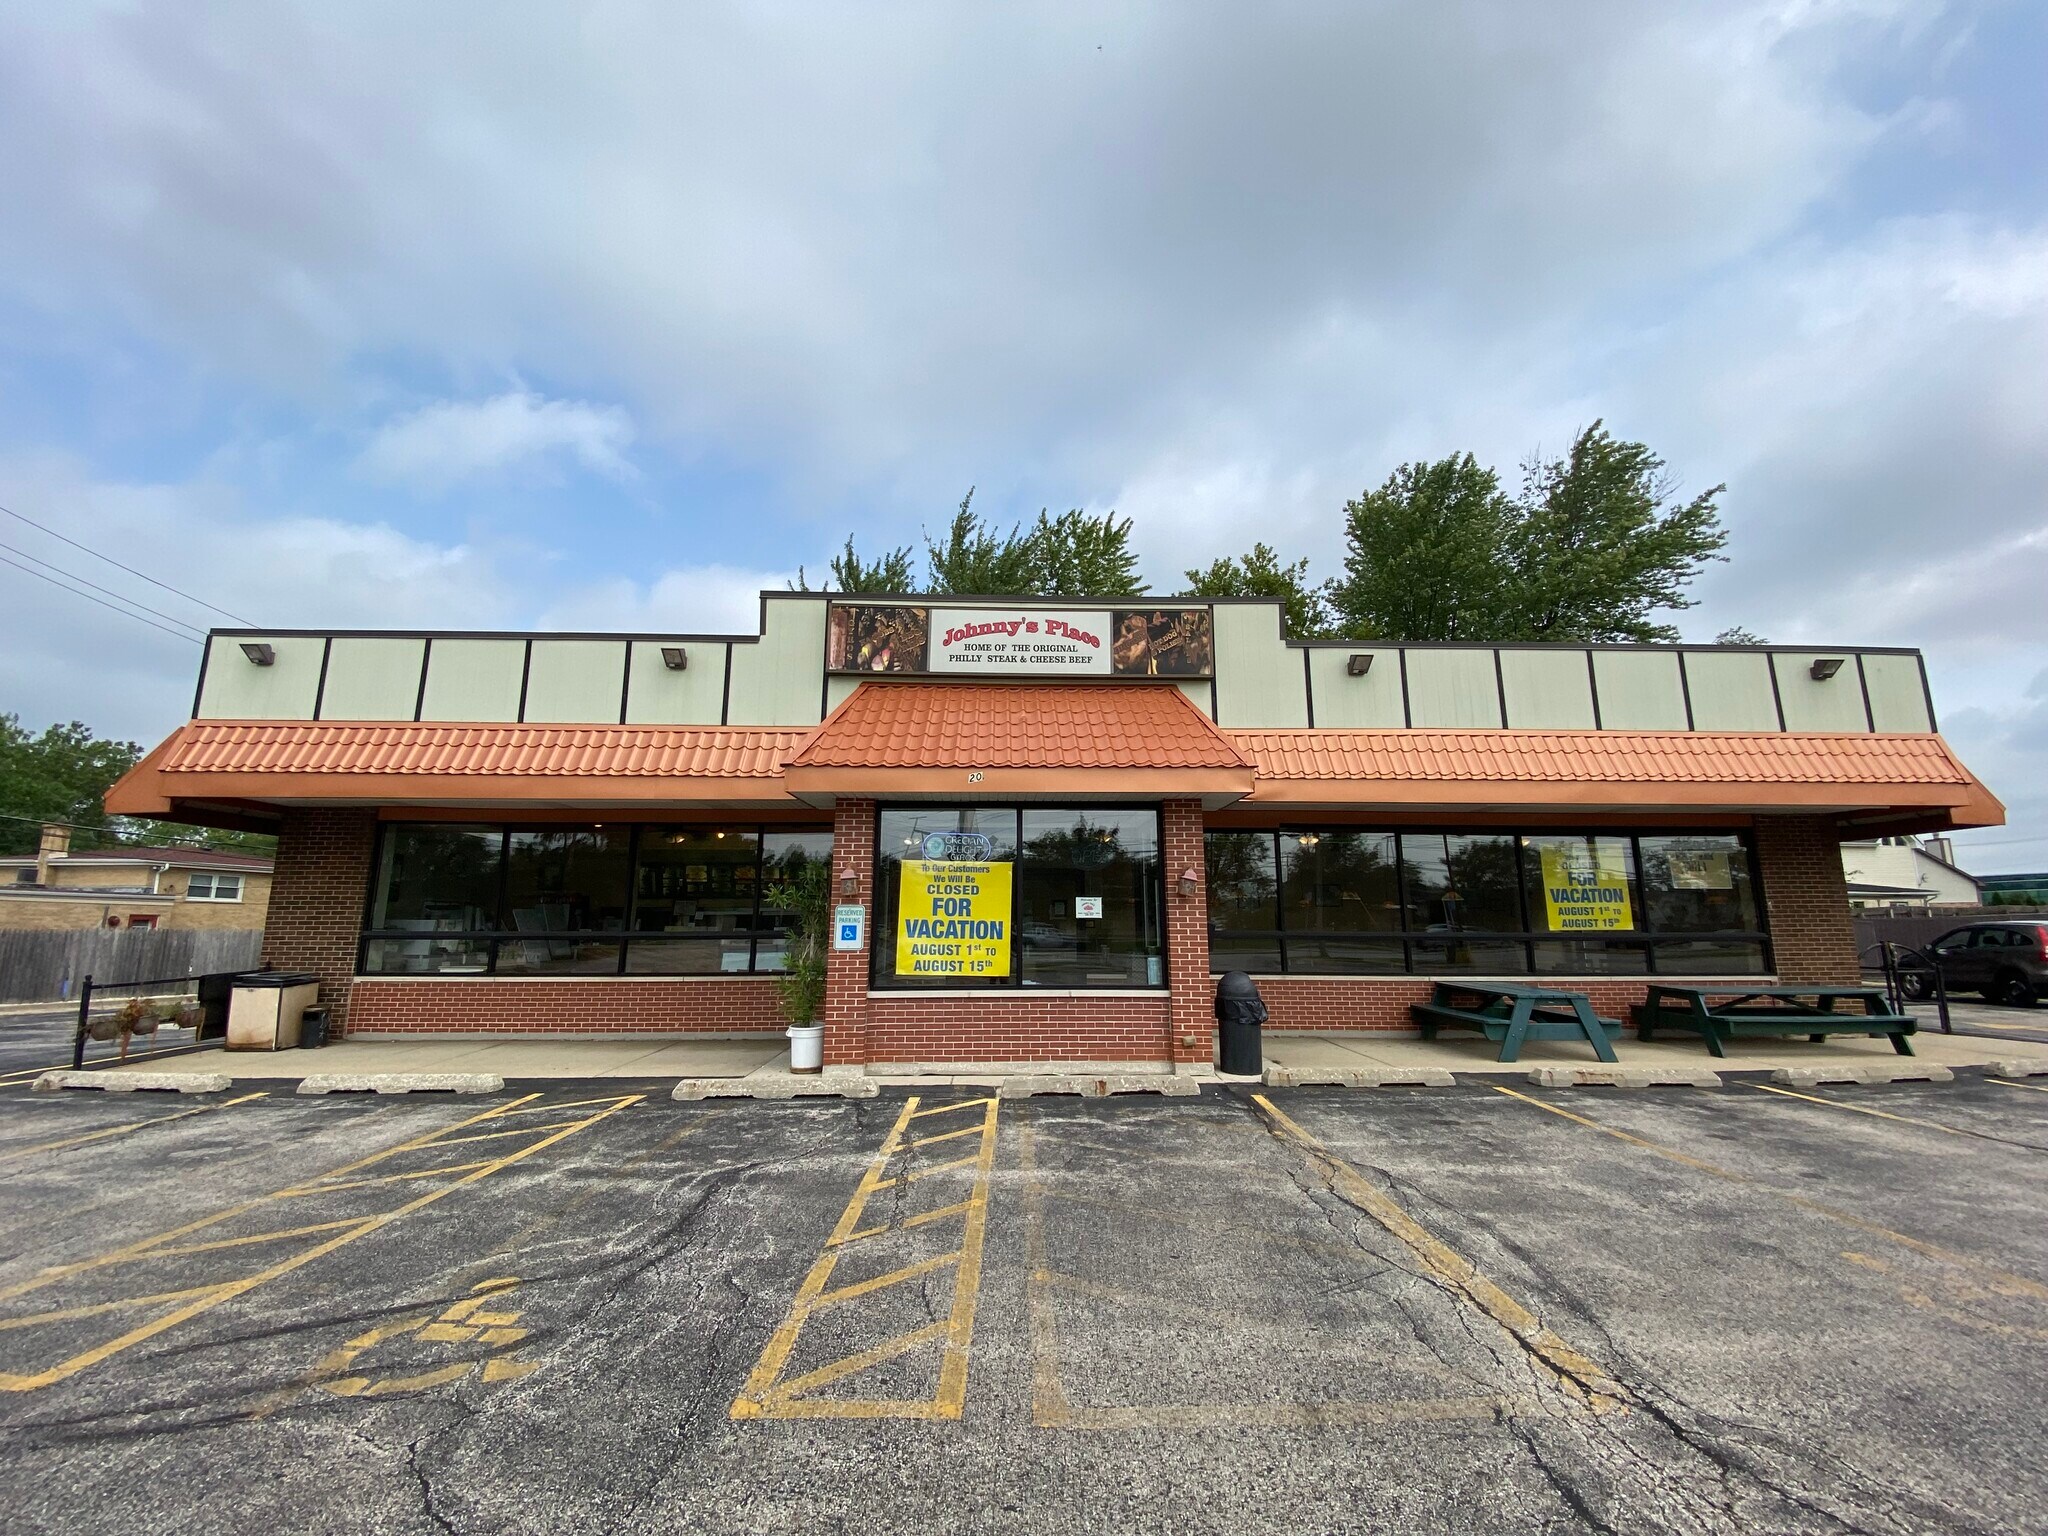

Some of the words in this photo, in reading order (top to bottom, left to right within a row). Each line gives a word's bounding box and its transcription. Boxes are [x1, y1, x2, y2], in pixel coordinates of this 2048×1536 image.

[943, 617, 1038, 646] Johnny's
[1045, 619, 1100, 648] Place
[987, 655, 1017, 663] STEAK
[1019, 655, 1027, 663] &
[921, 864, 930, 872] To
[932, 864, 946, 872] Our
[948, 864, 990, 873] Customers
[933, 875, 946, 883] We
[948, 875, 963, 883] Will
[965, 875, 976, 883] Be
[1568, 872, 1598, 886] FOR
[927, 884, 980, 895] CLOSED
[1549, 888, 1624, 903] VACATION
[932, 898, 972, 917] FOR
[1558, 907, 1595, 916] AUGUST
[905, 919, 1003, 940] VACATION
[1562, 919, 1599, 928] AUGUST
[911, 944, 961, 956] AUGUST
[966, 944, 981, 955] 1st
[985, 948, 997, 956] TO
[913, 960, 964, 972] AUGUST
[969, 960, 993, 972] 15th
